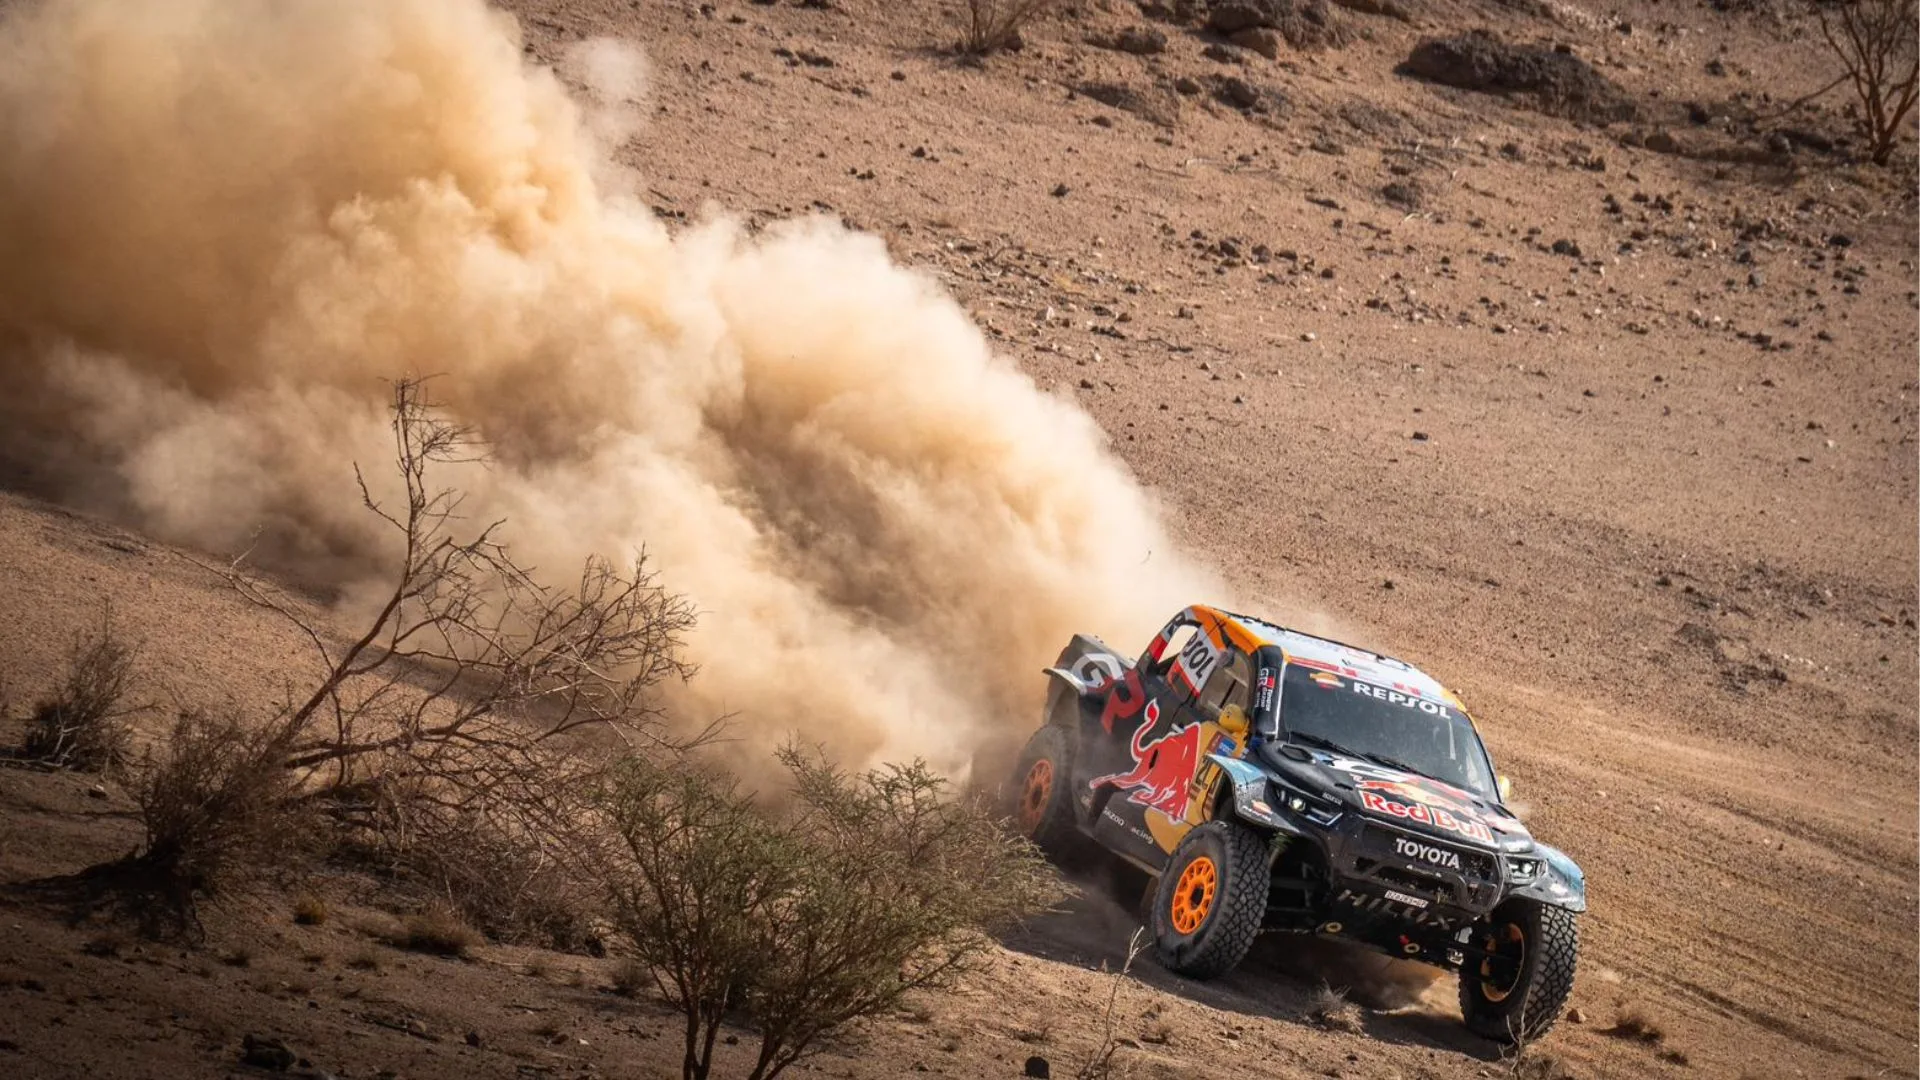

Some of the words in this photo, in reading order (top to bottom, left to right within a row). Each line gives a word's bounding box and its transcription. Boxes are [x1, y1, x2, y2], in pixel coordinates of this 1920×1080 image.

[1353, 681, 1452, 719] REPSOL
[1360, 790, 1432, 825] Red
[1431, 807, 1494, 844] Bull
[1395, 837, 1460, 869] TOYOTA
